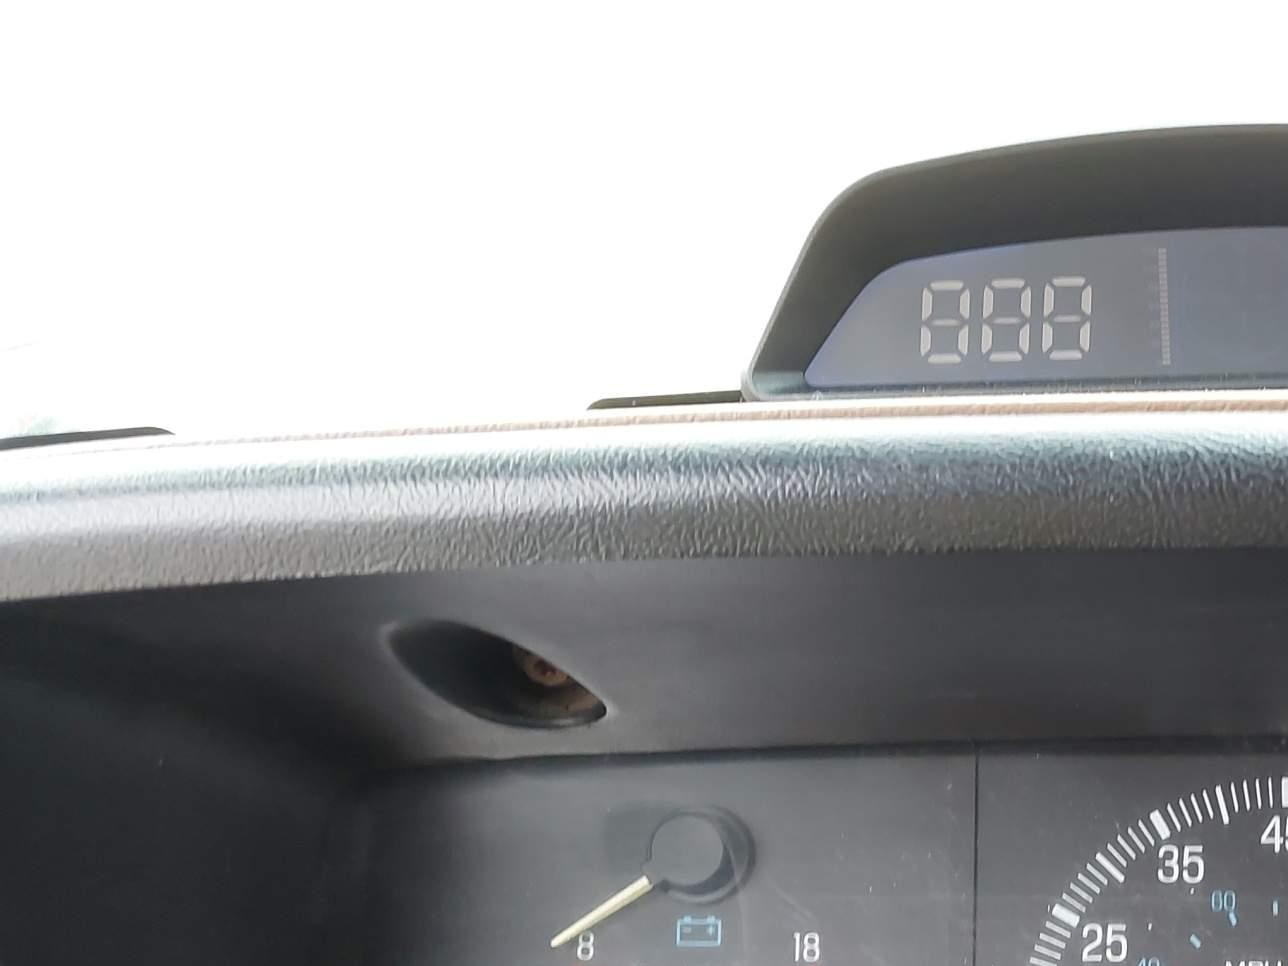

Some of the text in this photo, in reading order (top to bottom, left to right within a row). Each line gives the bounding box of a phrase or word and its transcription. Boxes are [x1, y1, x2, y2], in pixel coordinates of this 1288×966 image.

[1157, 844, 1205, 884] 35
[1210, 890, 1236, 911] 60
[577, 931, 595, 961] 8
[793, 931, 820, 962] 18
[1081, 922, 1128, 963] 25
